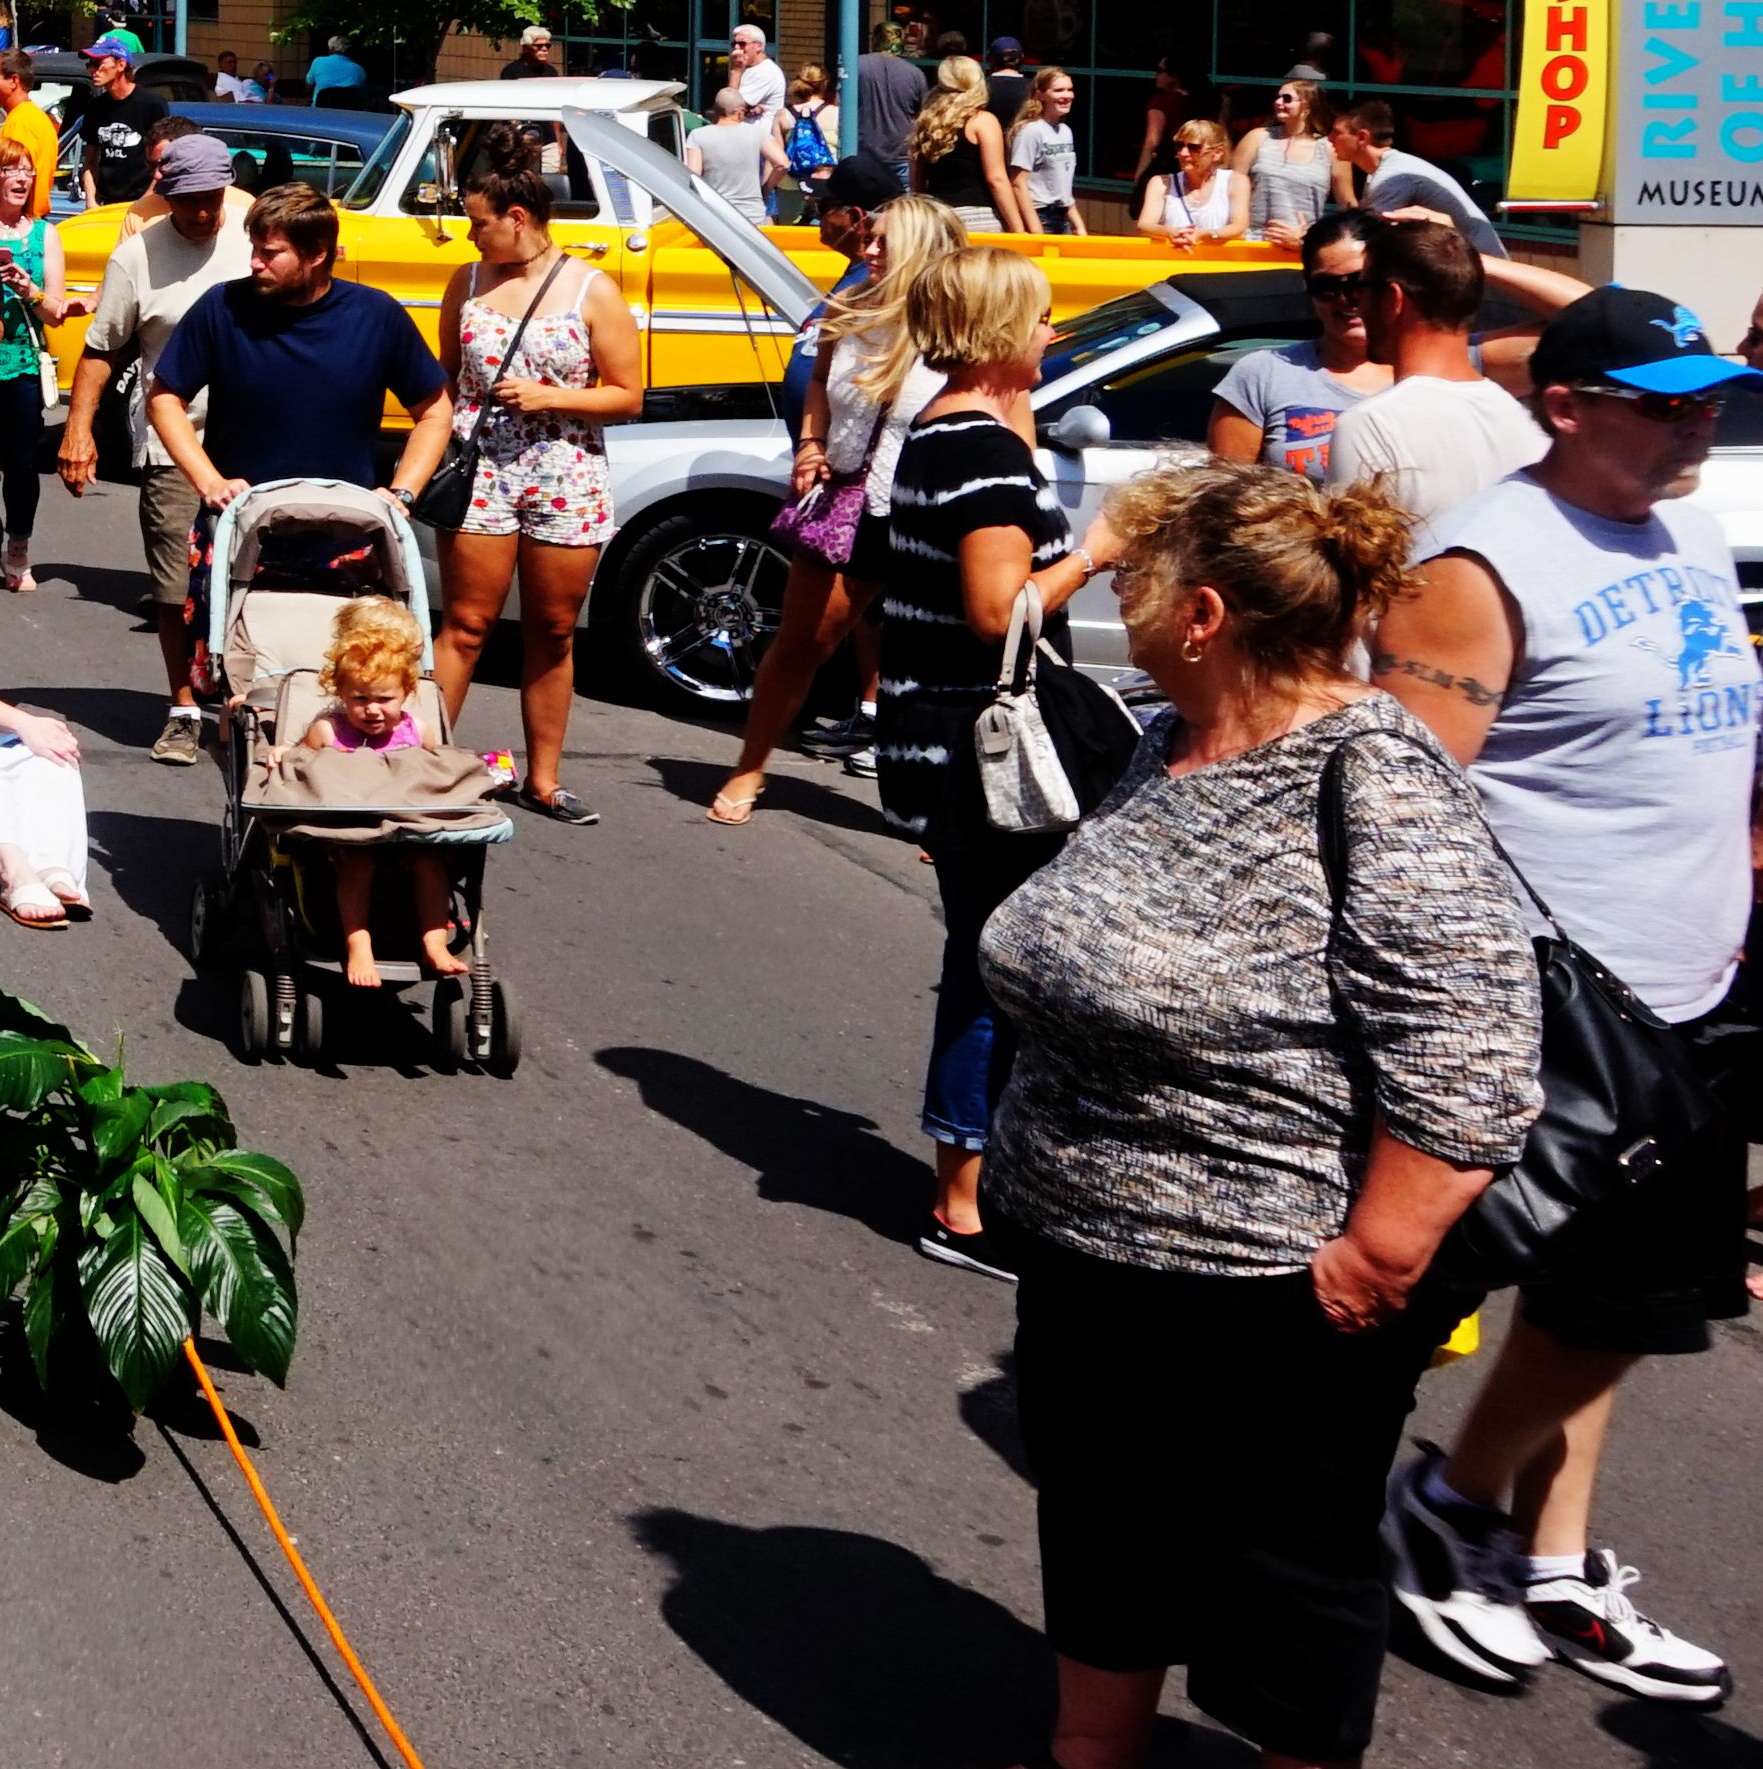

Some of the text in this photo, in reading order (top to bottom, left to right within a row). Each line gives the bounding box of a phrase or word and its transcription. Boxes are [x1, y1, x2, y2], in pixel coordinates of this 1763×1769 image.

[1719, 74, 1763, 163] OF
[116, 357, 143, 393] DAYT
[1643, 682, 1763, 738] LION
